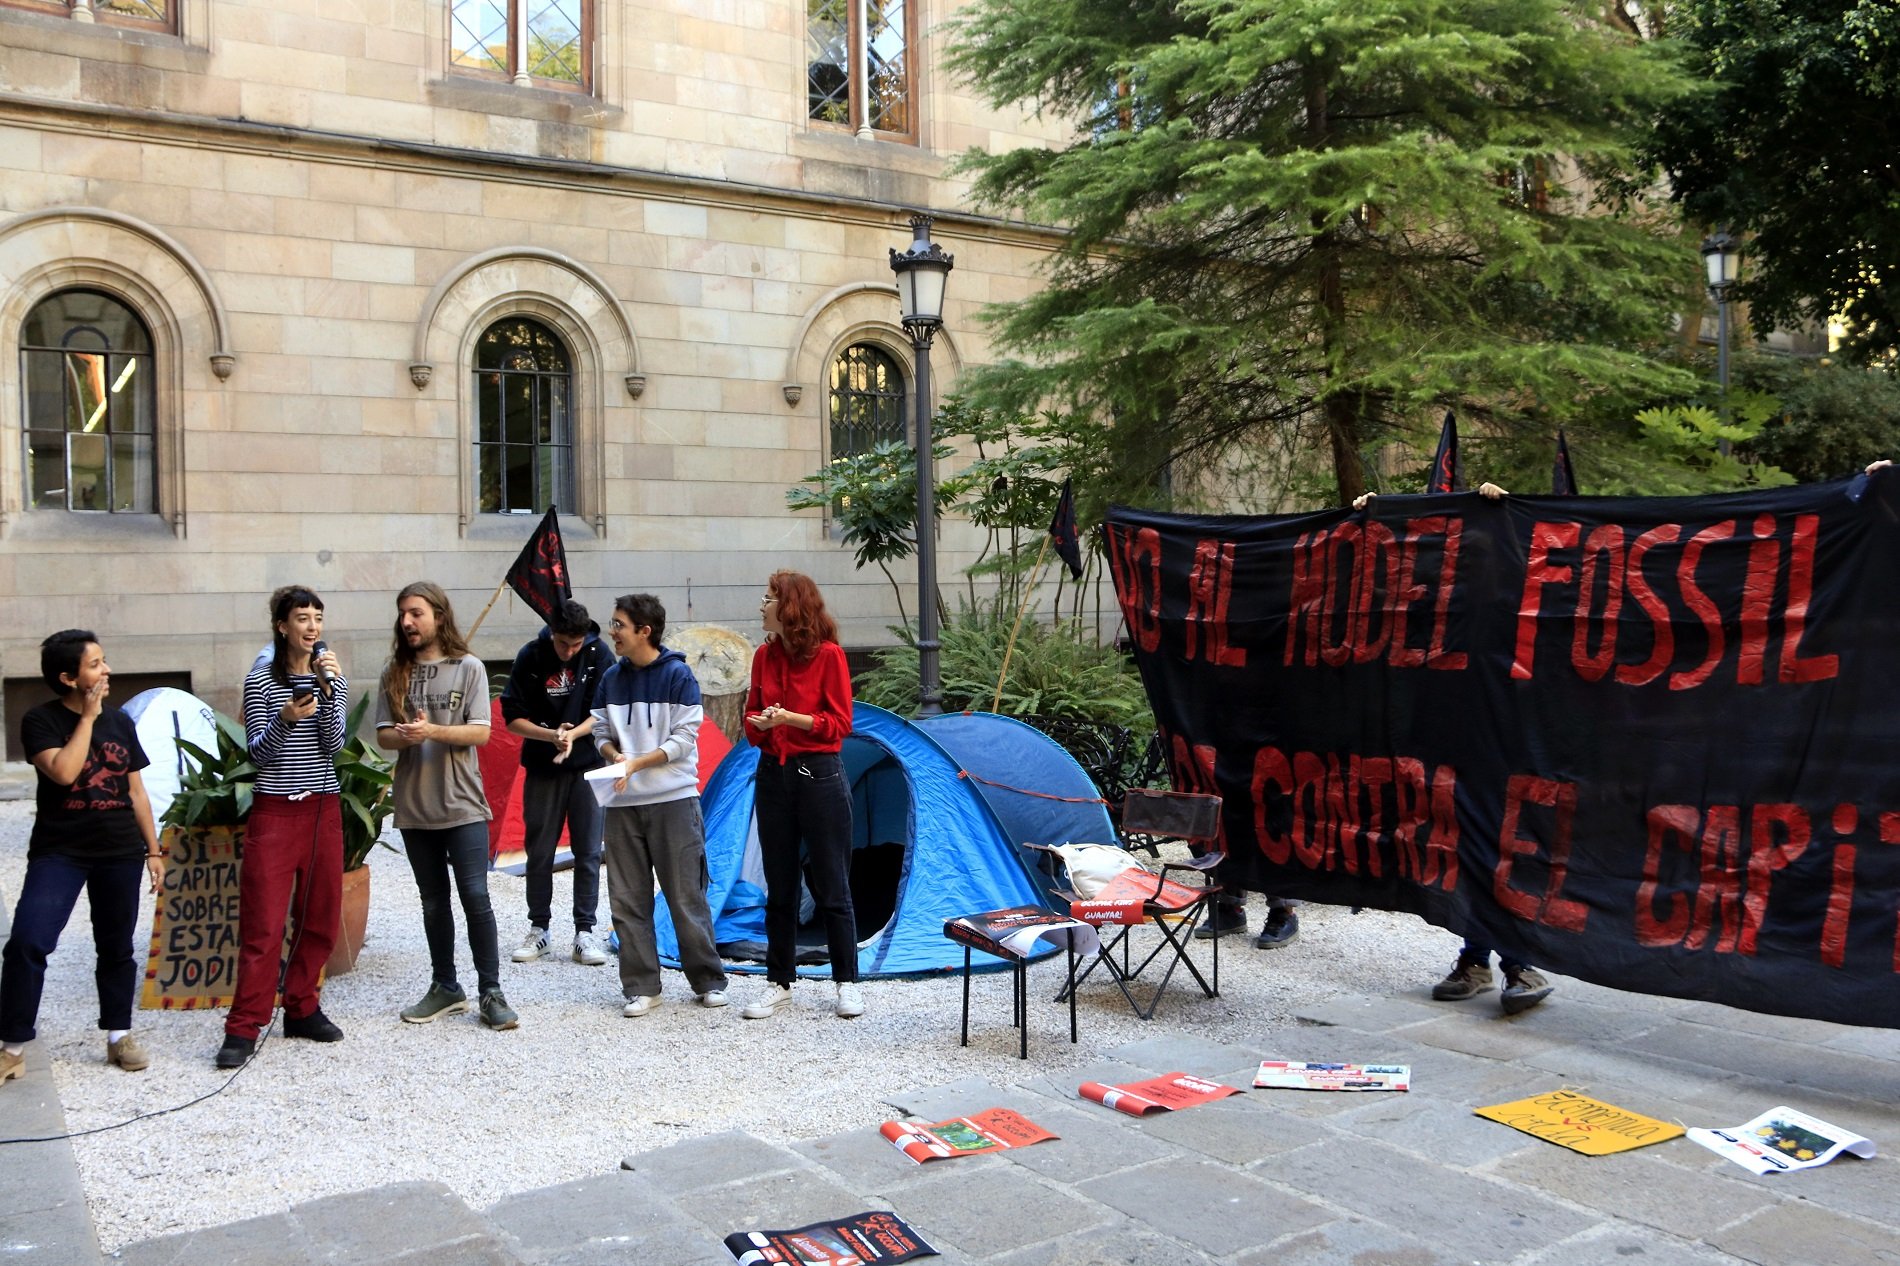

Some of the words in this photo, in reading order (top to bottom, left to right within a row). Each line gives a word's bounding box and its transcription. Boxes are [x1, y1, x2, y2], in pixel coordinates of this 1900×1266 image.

[1185, 538, 1246, 667] AL
[1284, 516, 1468, 670] MODEL
[172, 831, 211, 865] SI
[233, 832, 245, 860] E
[1250, 746, 1460, 892] CONTRA
[1494, 774, 1590, 933] EL
[163, 863, 239, 892] CAPITA
[168, 923, 241, 953] ESTA
[160, 954, 235, 992] JODI
